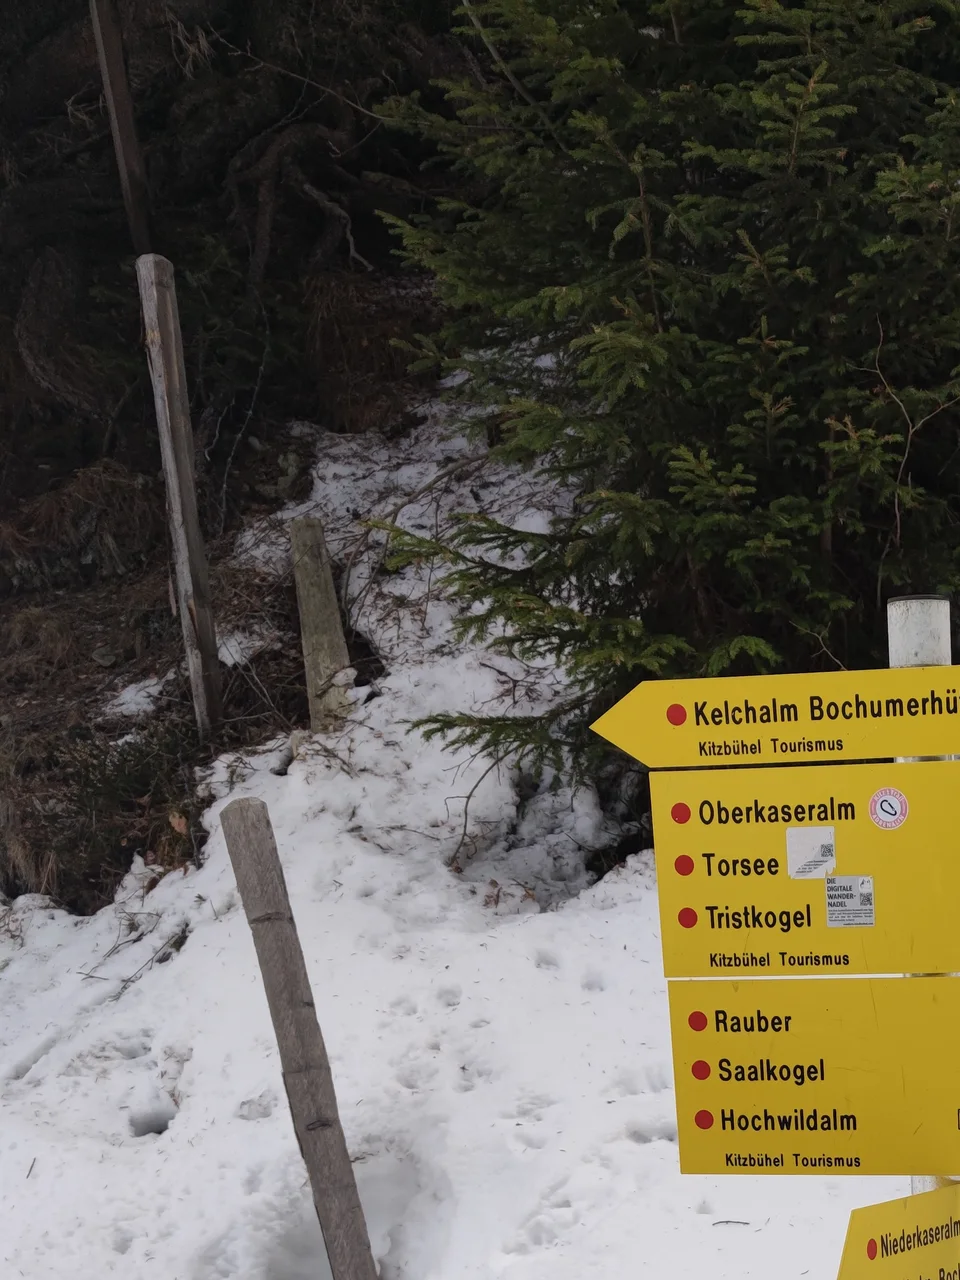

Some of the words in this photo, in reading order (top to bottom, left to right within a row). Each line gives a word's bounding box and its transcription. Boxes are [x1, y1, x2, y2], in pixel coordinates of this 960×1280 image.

[695, 698, 798, 726] Kelchalm
[699, 739, 761, 756] Kitzbühel
[771, 737, 843, 753] Tourismus
[699, 797, 855, 825] Oberkaseralm
[702, 853, 779, 876] Torsee
[705, 904, 811, 932] Tristkogel
[710, 953, 770, 967] Kitzbühel
[779, 952, 849, 966] Tourismus
[715, 1010, 791, 1032] Rauber
[719, 1059, 824, 1085] Saalkogel
[721, 1109, 856, 1131] Hochwildalm
[726, 1154, 783, 1166] Kitzbühel
[793, 1154, 860, 1167] Tourismus
[881, 1217, 960, 1258] Niederkaseralm
